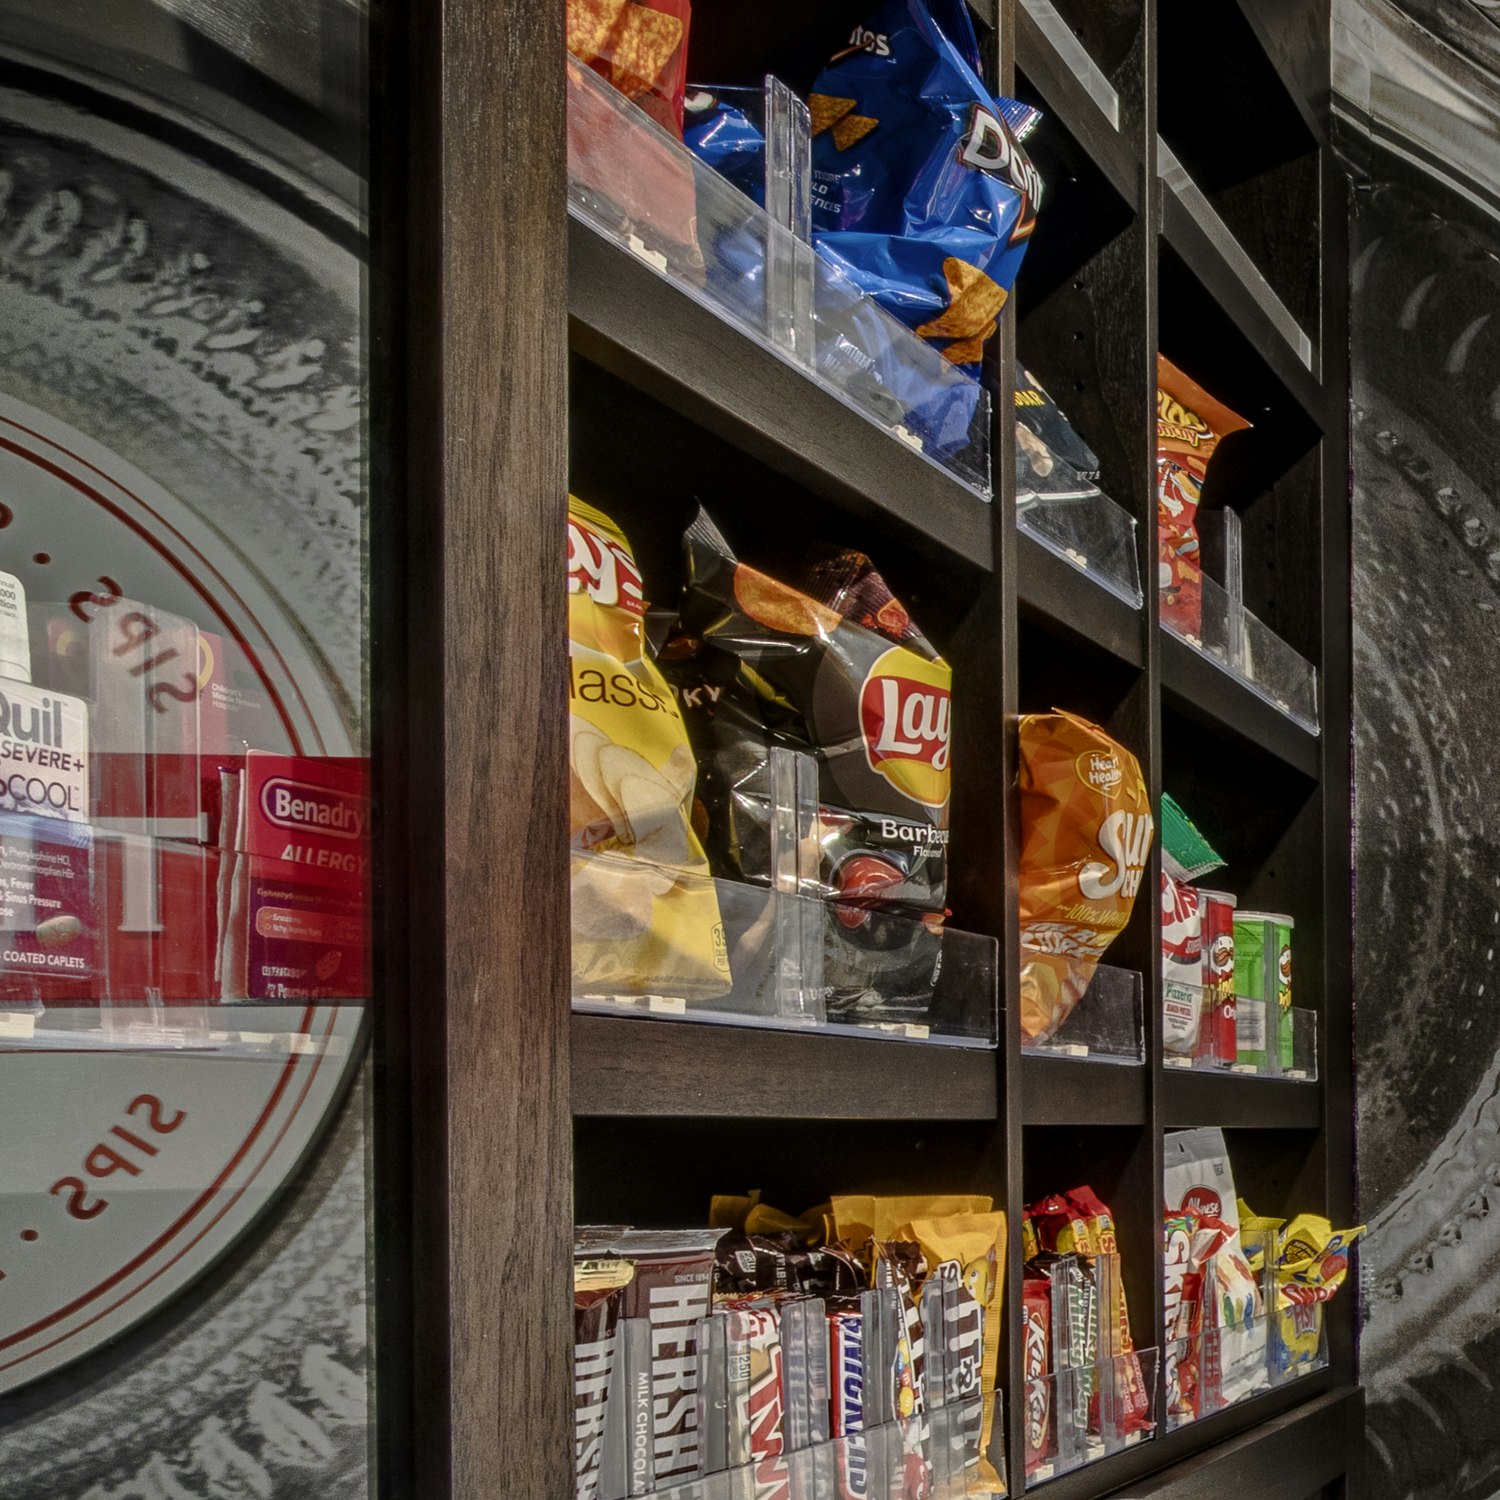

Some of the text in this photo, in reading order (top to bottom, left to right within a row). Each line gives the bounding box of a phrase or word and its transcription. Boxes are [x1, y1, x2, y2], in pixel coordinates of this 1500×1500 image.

[3, 950, 85, 969] COATED CAPLETS
[738, 1355, 751, 1379] 250
[636, 1371, 649, 1408] MILK
